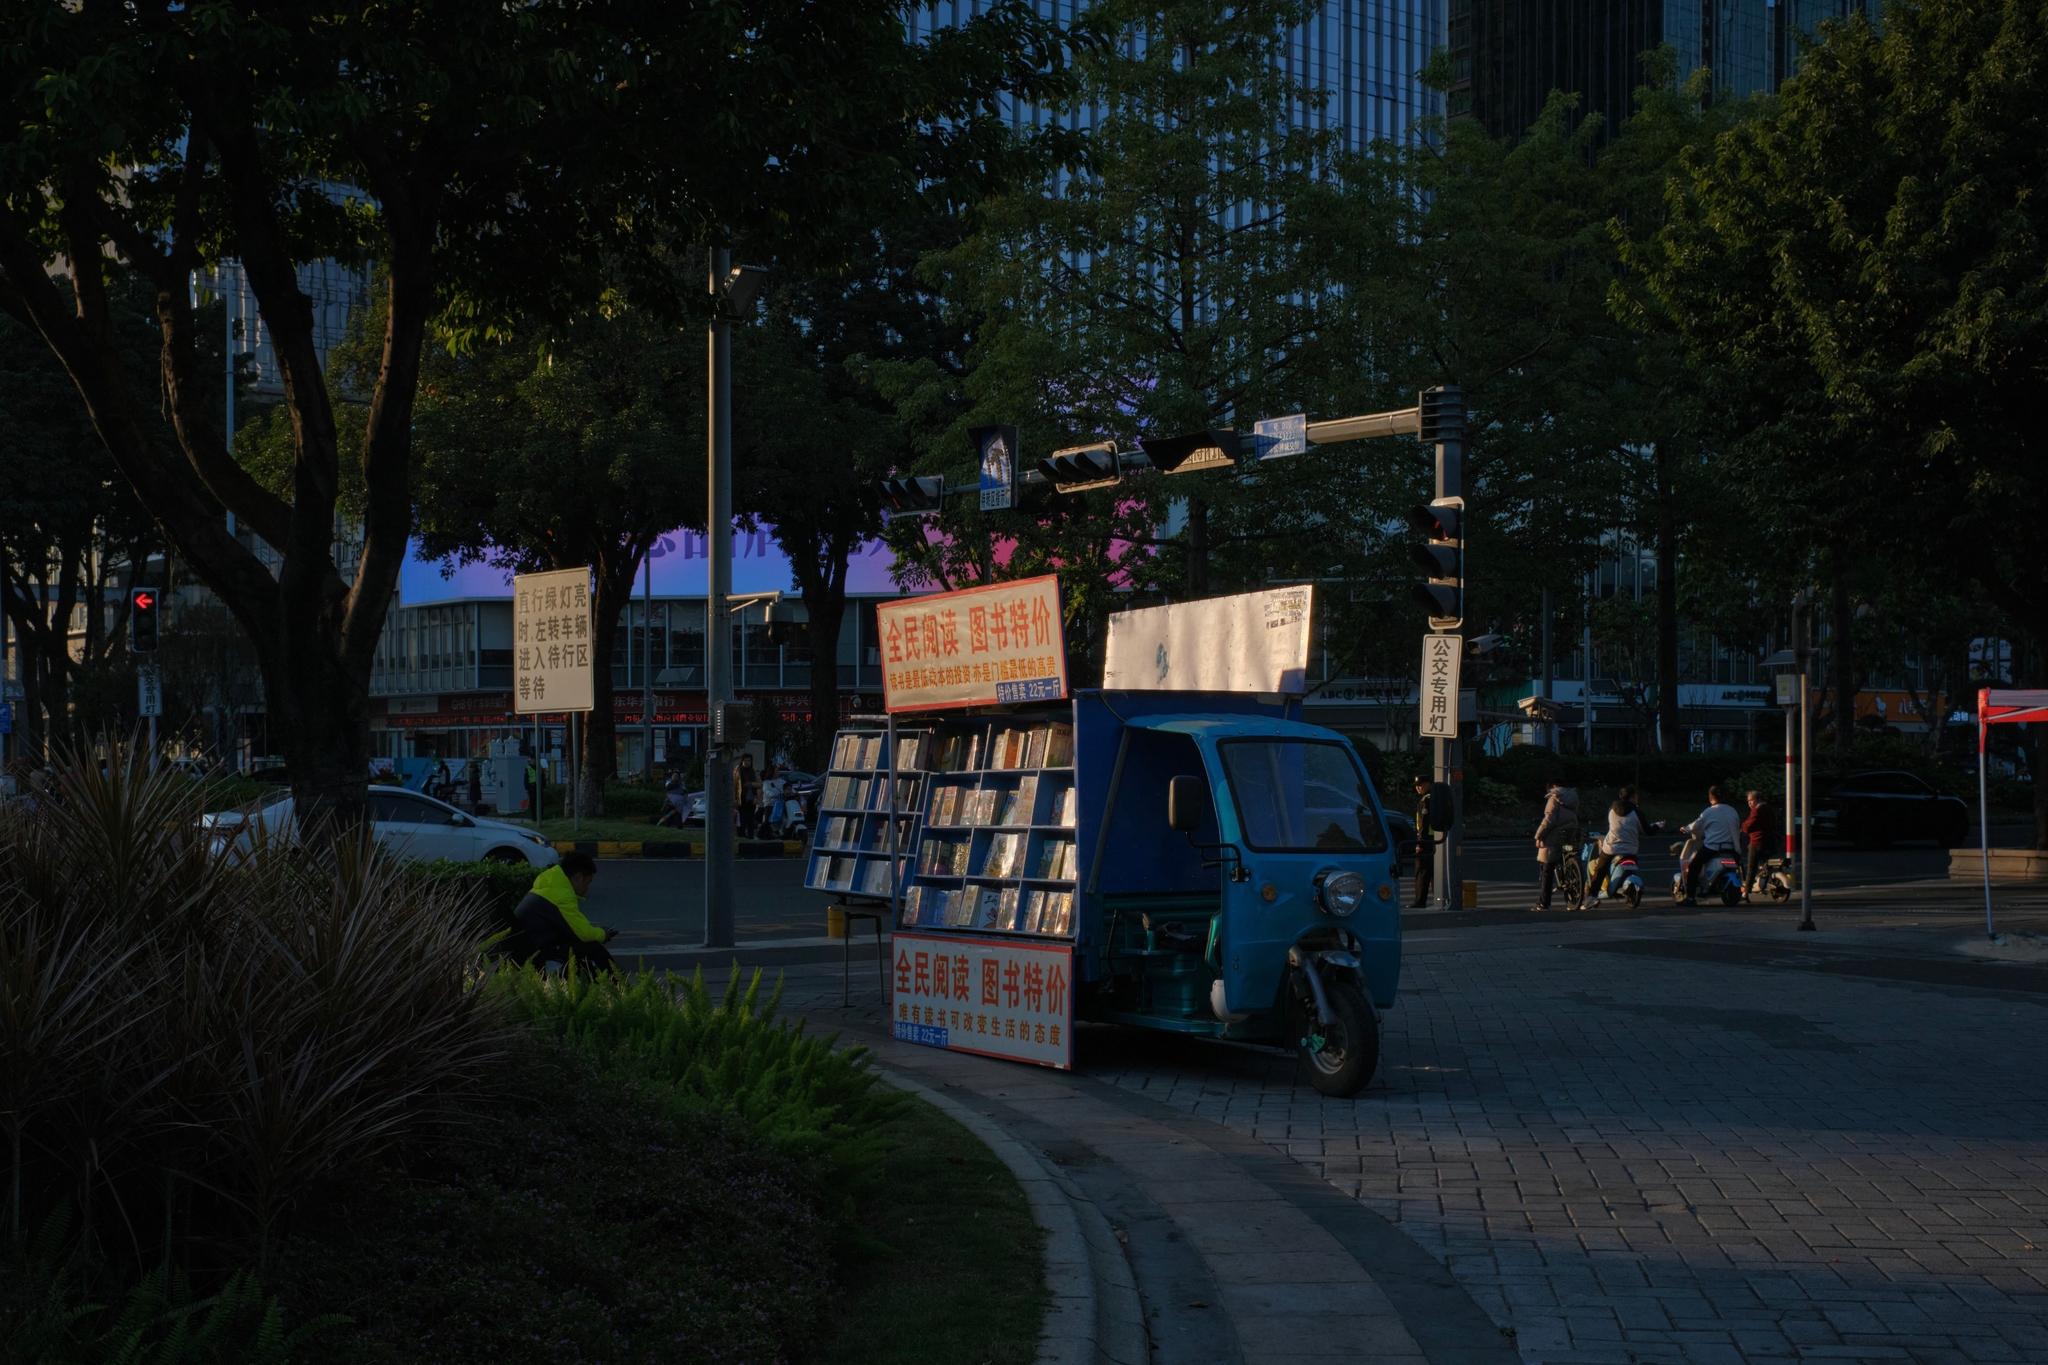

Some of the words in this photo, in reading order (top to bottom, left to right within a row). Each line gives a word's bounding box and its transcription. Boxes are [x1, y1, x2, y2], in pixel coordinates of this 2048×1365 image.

[518, 583, 587, 614] 直行绿灯亮
[886, 609, 959, 663] 全民阅读
[969, 595, 1050, 654] 图书特价
[519, 643, 589, 671] 进入待行区
[519, 675, 545, 700] 等待
[889, 664, 971, 692] 读书是最低成本的投资
[997, 682, 1026, 702] 特价售卖
[1029, 679, 1060, 698] 22元一斤
[1430, 639, 1451, 732] 公交专用灯
[1320, 690, 1342, 699] ABC
[896, 949, 970, 1002] 全民阅读
[981, 958, 1066, 1016] 图书特价
[899, 1003, 1061, 1047] 唯有读书可改变生活的态度
[921, 1028, 948, 1046] 22元一斤
